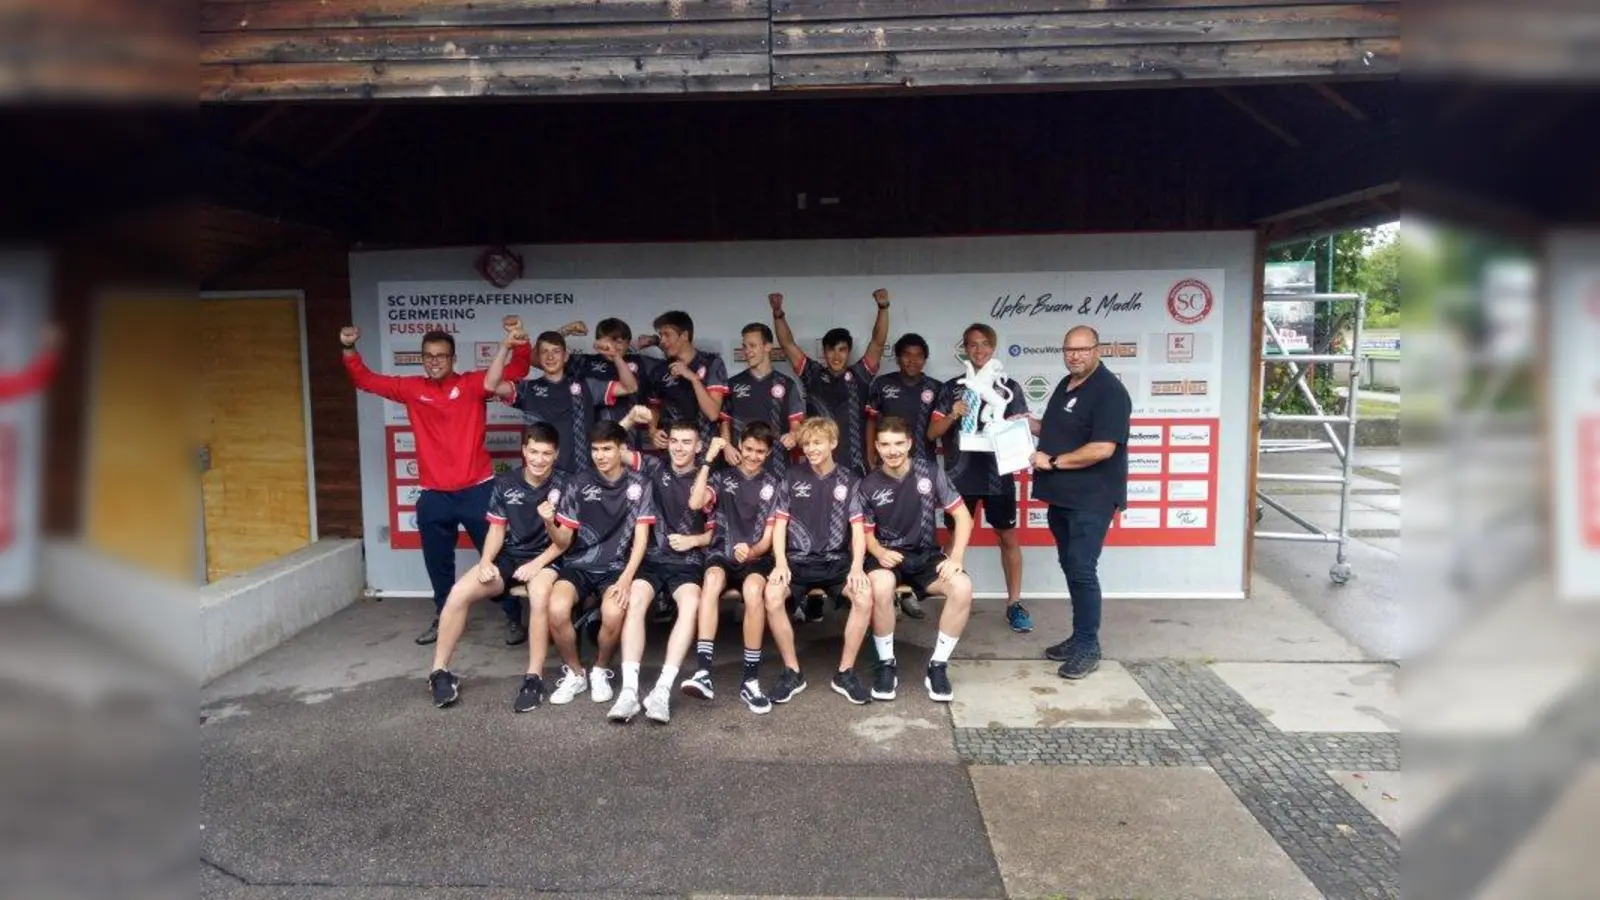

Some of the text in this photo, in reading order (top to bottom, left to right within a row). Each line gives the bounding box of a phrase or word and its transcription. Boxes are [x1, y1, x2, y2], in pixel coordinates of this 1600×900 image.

[387, 292, 574, 307] SC UNTERPFAFFENHOFEN
[989, 293, 1032, 320] Upfer
[1028, 293, 1073, 317] Buam
[1077, 296, 1093, 315] &
[1176, 293, 1204, 311] SC
[387, 307, 476, 321] GERMERING
[388, 322, 461, 335] FUSSBALL
[1022, 345, 1065, 355] DocuWar
